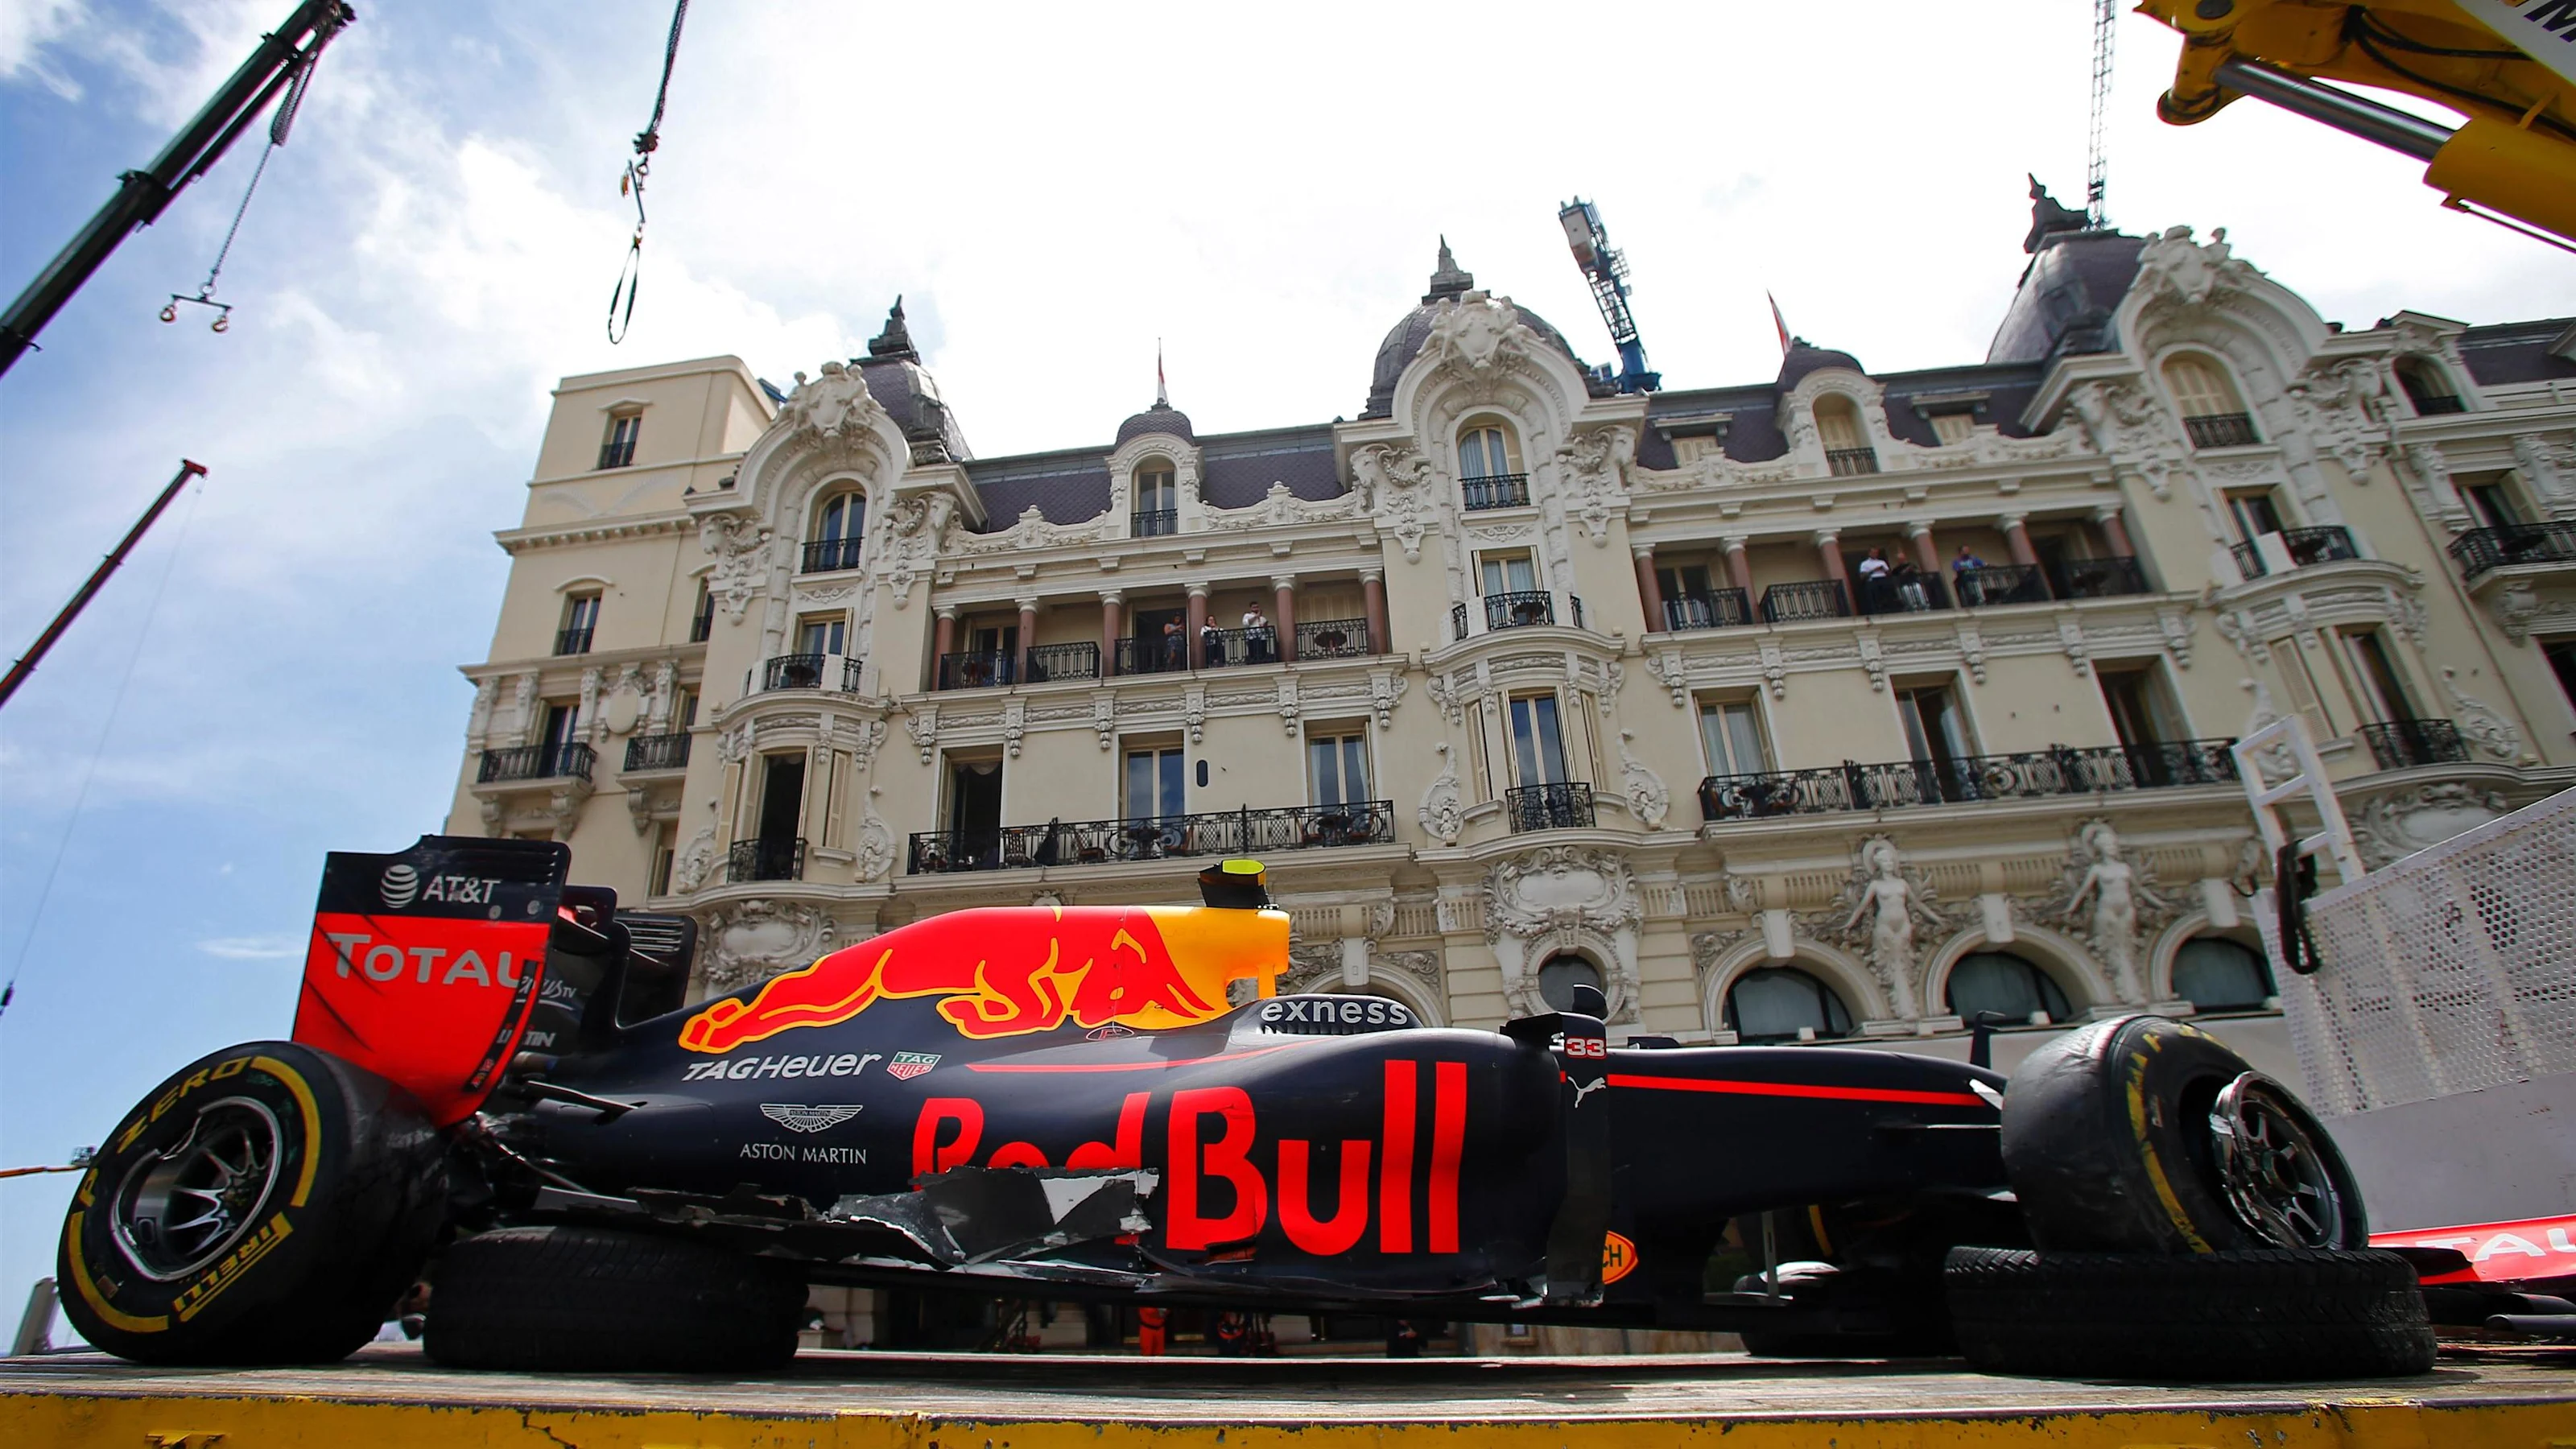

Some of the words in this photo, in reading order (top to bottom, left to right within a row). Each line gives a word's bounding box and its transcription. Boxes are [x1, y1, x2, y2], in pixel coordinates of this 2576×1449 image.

[421, 875, 501, 904] AT&T
[326, 932, 523, 989] TOTAL
[1261, 1000, 1408, 1026] exness
[898, 1054, 935, 1064] TAG
[1567, 1038, 1606, 1058] 33
[890, 1064, 931, 1077] HEUER
[118, 1056, 252, 1154] ZERO
[740, 1143, 795, 1161] ASTON
[803, 1146, 867, 1165] MARTIN
[1166, 1059, 1468, 1256] Bull
